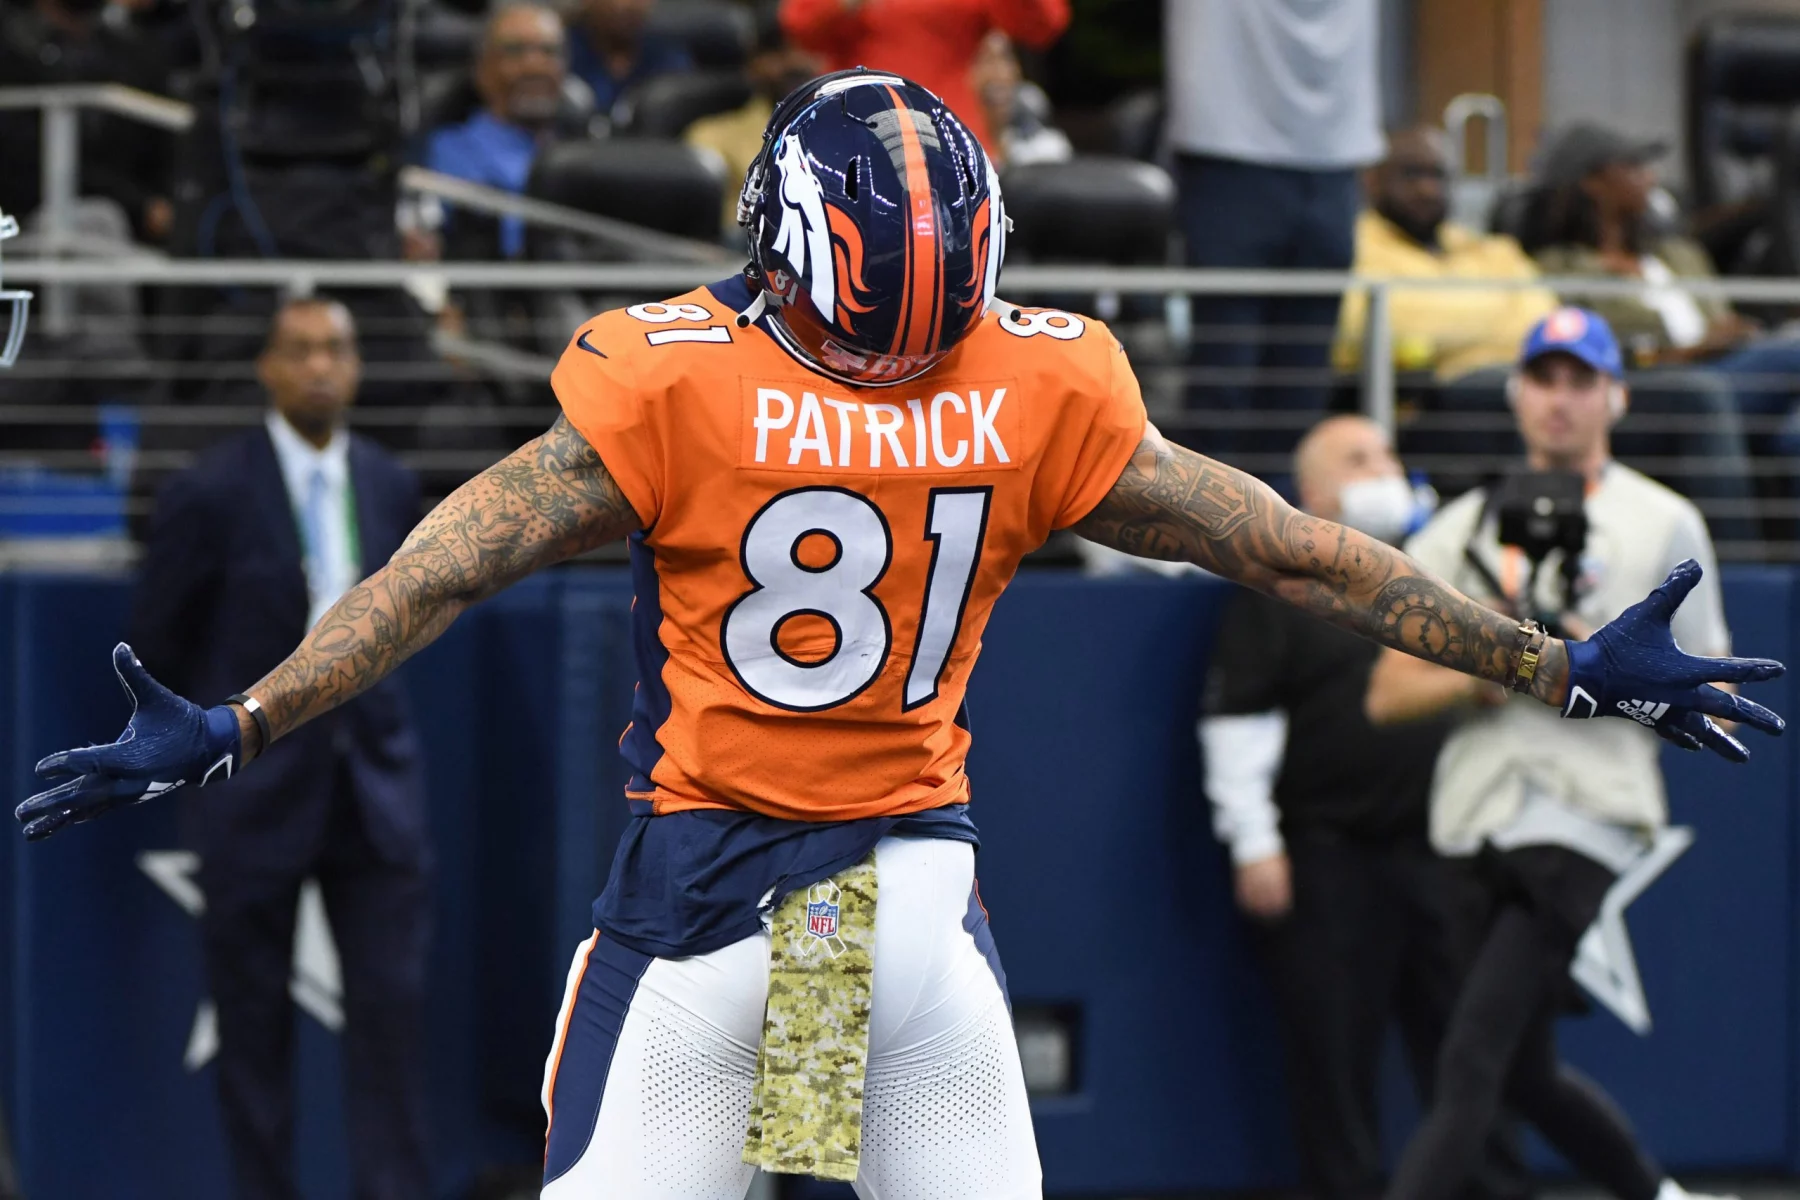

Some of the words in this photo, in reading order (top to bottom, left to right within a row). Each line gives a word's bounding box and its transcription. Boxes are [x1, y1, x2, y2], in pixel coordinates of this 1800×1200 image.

[625, 302, 735, 347] 81
[998, 307, 1085, 340] 8
[754, 387, 1010, 468] PATRICK
[720, 485, 993, 713] 81
[1616, 700, 1656, 726] adidas
[810, 915, 835, 934] NFL
